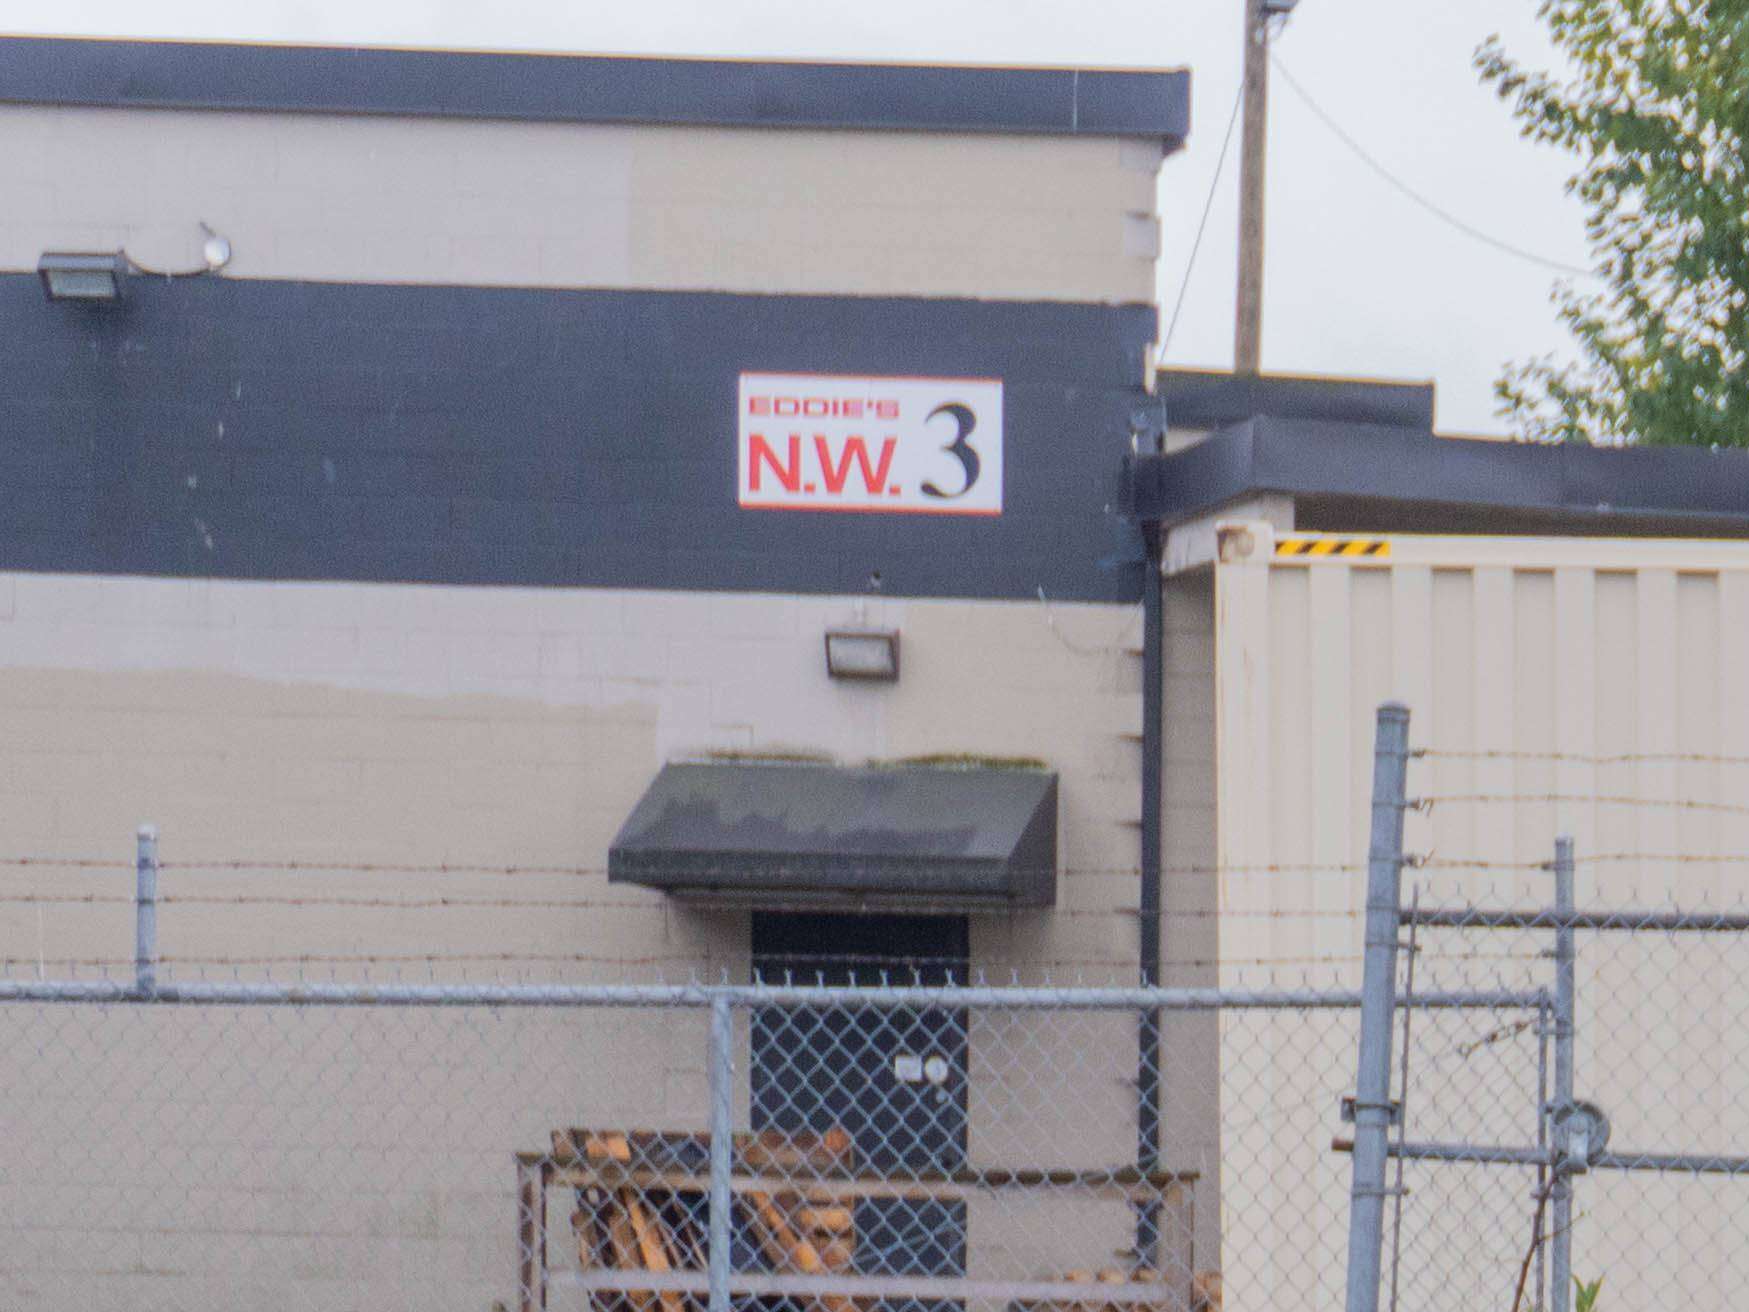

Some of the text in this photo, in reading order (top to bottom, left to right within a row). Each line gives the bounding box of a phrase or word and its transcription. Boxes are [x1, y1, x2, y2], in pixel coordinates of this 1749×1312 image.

[749, 396, 899, 418] EDDIE'S
[748, 401, 981, 497] N.W. 3
